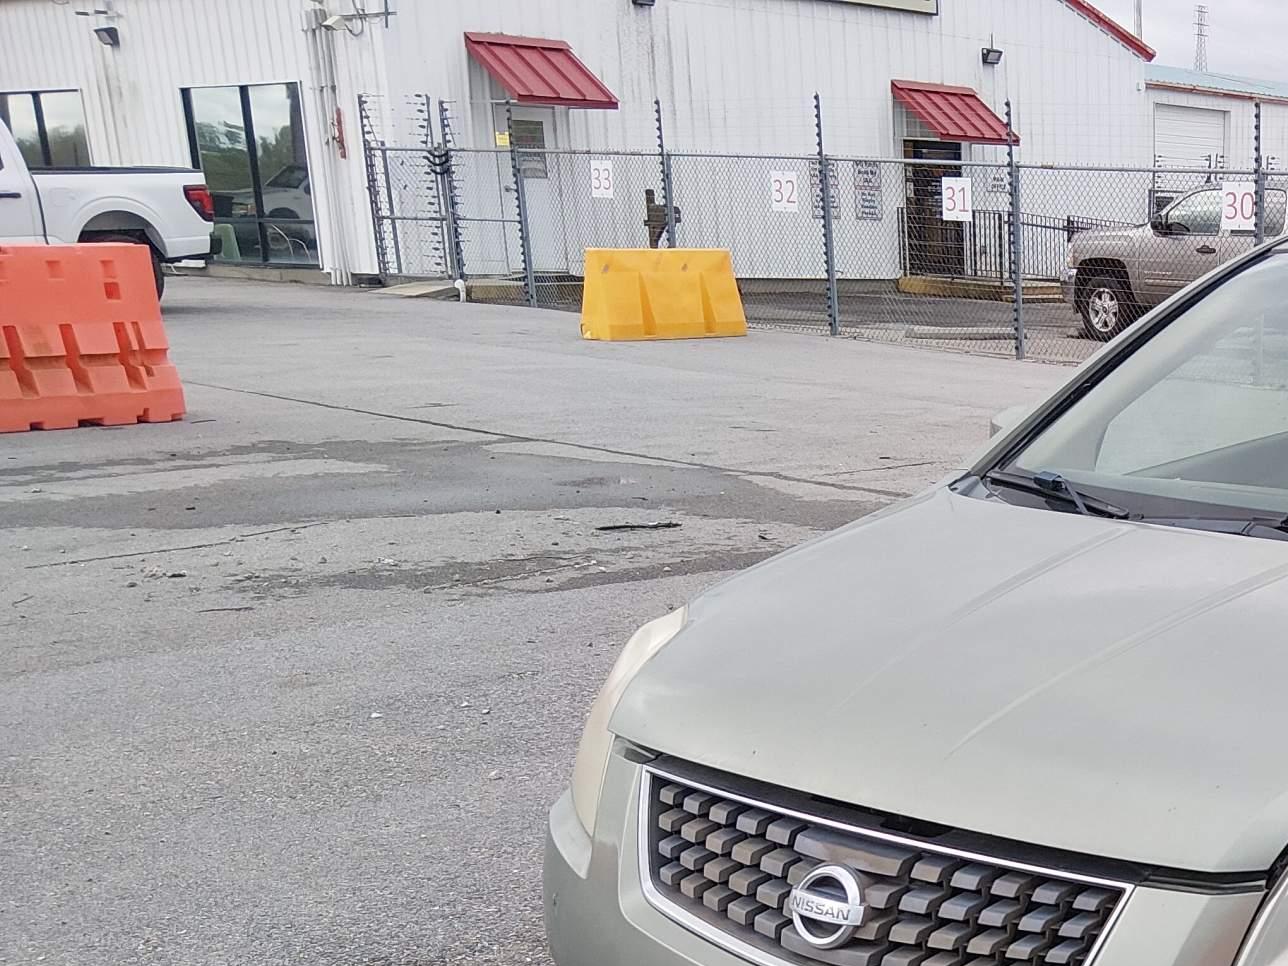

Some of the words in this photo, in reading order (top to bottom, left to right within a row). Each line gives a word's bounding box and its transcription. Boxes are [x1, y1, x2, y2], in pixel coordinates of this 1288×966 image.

[592, 167, 612, 190] 33
[773, 178, 797, 205] 32
[944, 186, 970, 213] 31
[1225, 191, 1256, 220] 30
[792, 895, 850, 921] NISSAN
